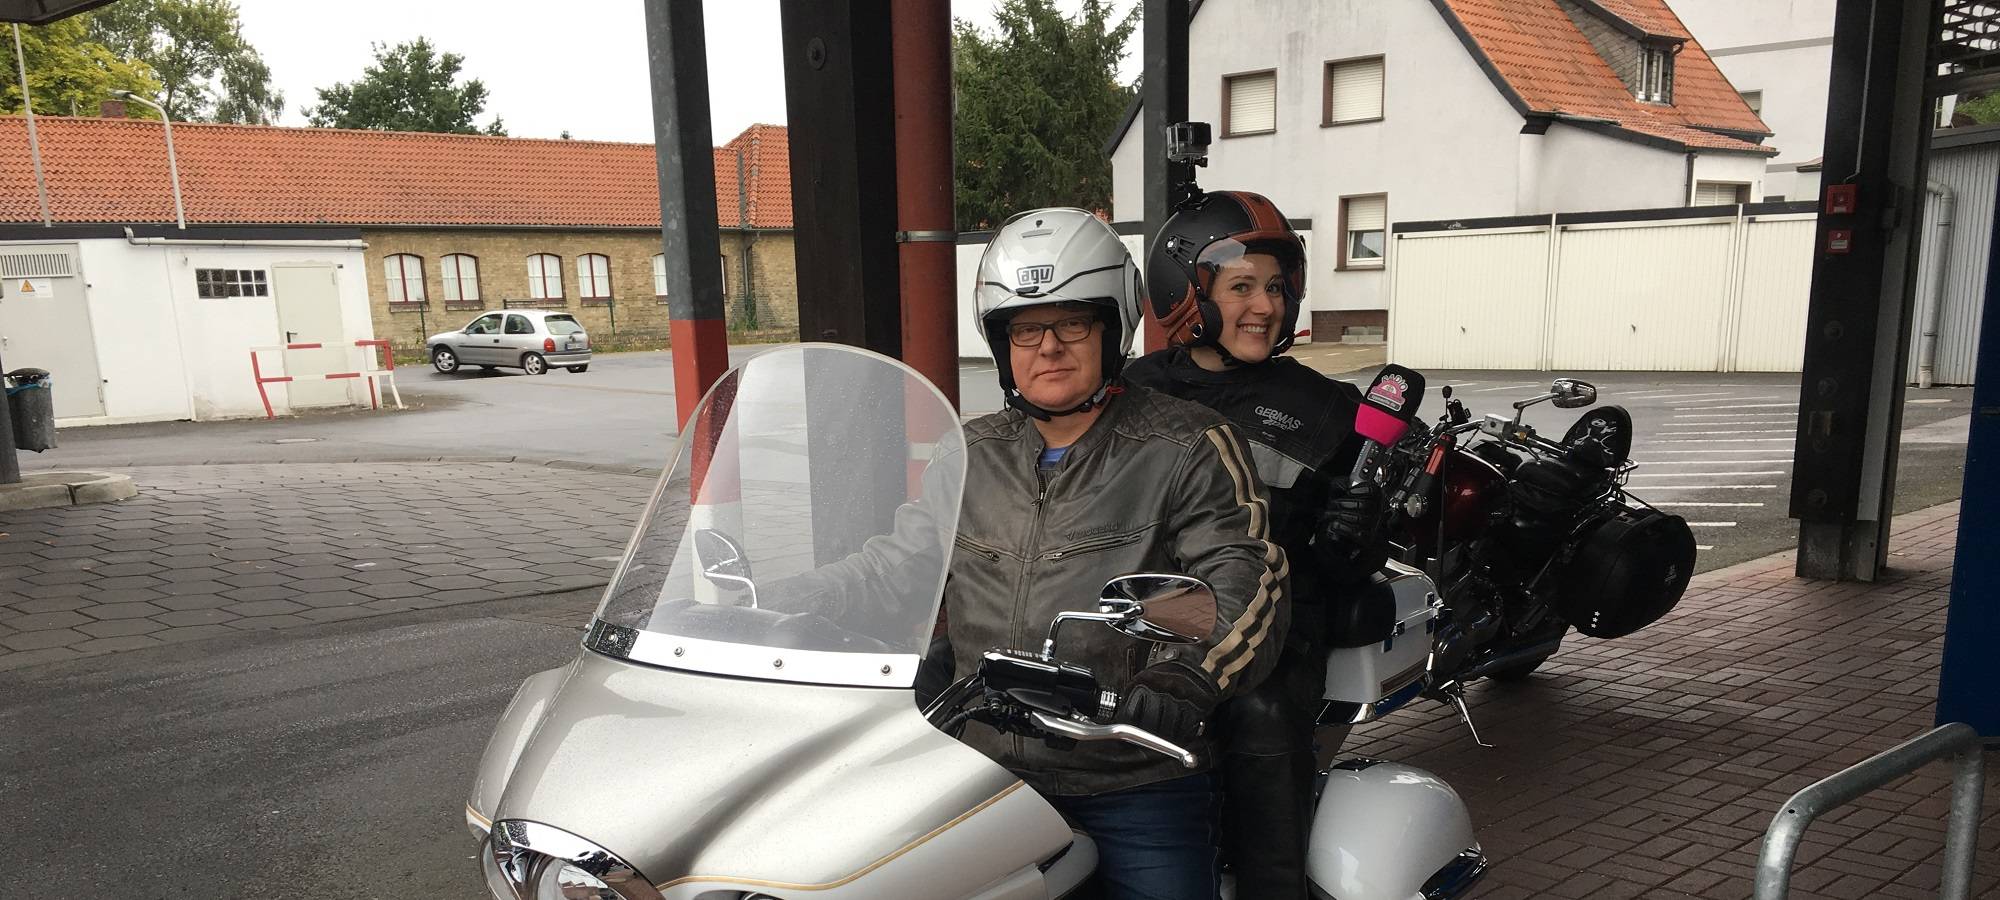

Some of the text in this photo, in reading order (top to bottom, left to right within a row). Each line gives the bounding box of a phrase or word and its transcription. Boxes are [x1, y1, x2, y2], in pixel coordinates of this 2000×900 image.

[1021, 268, 1051, 284] agv
[1381, 373, 1409, 392] RADIO
[1254, 405, 1301, 429] GERMAS
